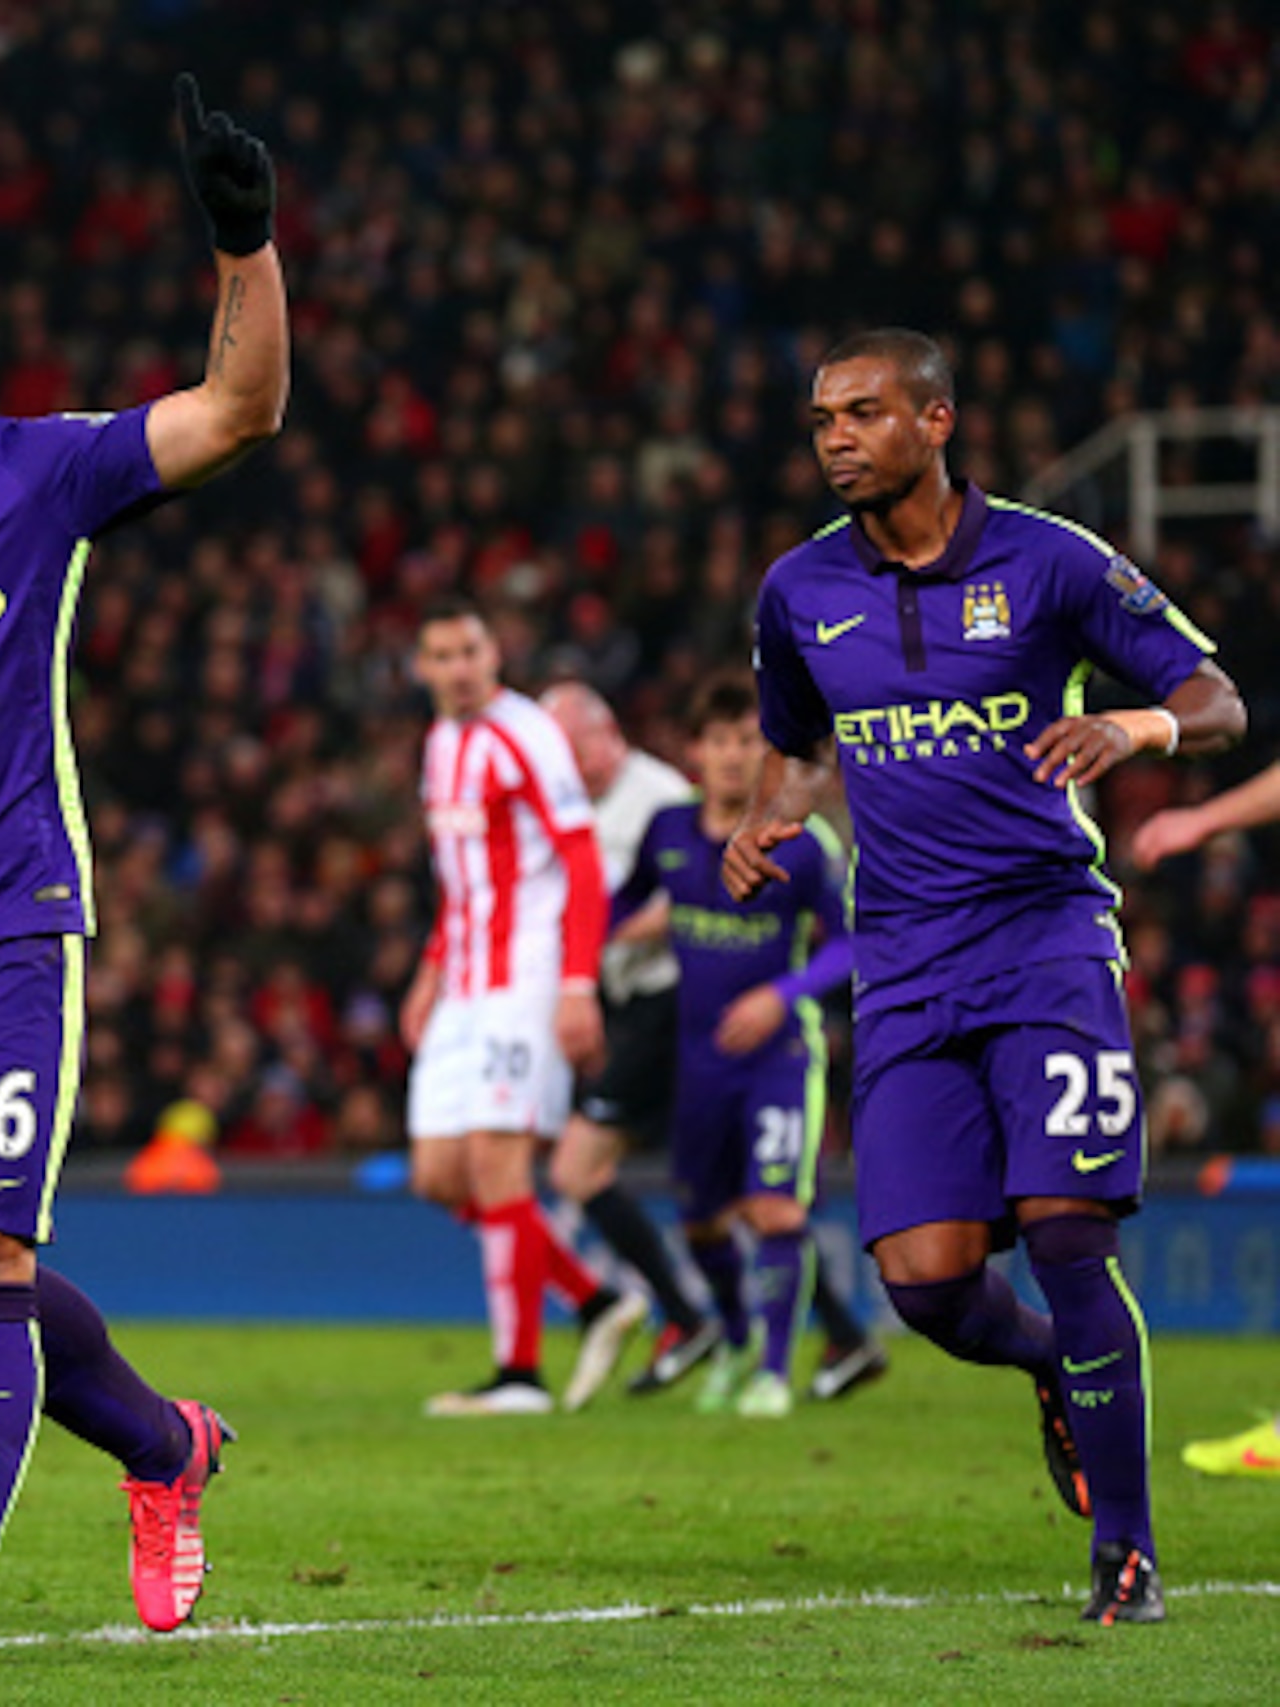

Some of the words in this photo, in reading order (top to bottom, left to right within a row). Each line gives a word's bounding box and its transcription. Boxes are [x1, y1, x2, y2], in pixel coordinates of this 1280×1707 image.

[834, 692, 1030, 744] ETIHAD
[1044, 1051, 1137, 1136] 25
[753, 1104, 804, 1162] 21
